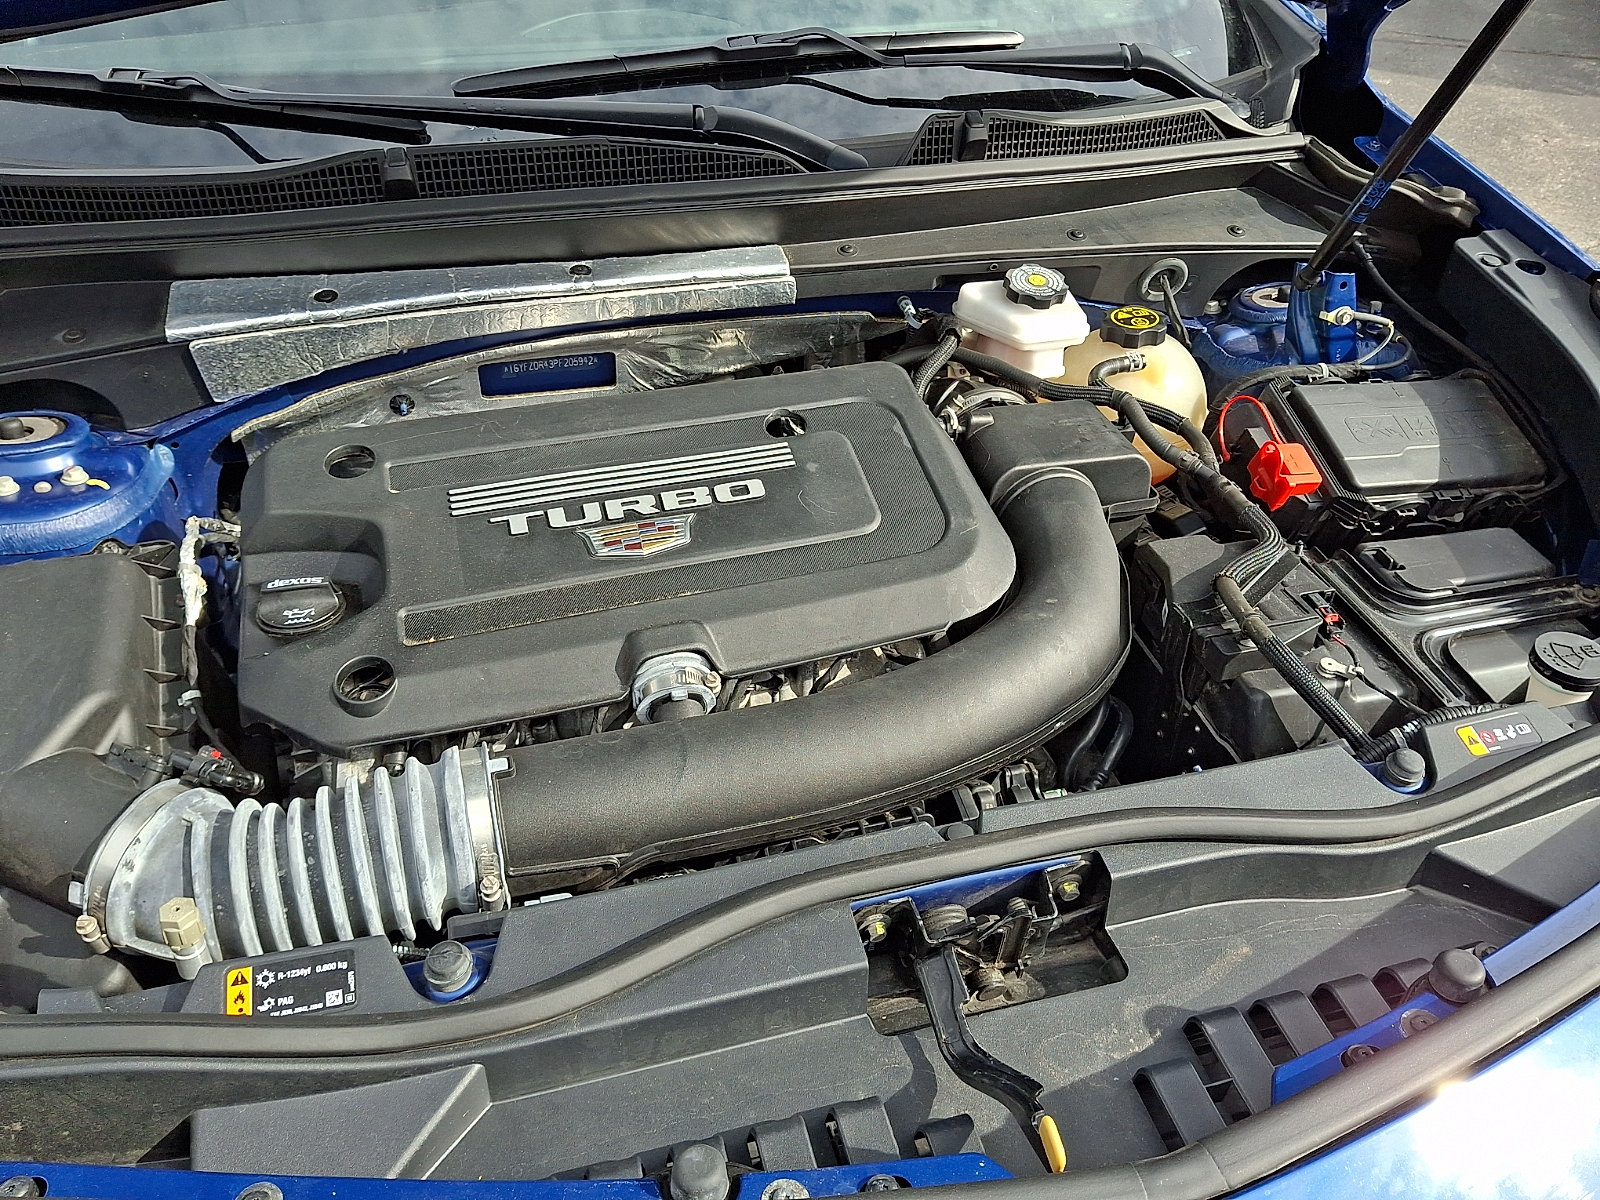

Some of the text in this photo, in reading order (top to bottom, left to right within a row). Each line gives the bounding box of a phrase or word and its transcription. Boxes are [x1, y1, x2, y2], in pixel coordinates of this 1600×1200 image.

[489, 478, 766, 536] TURBO
[266, 576, 325, 589] dexos
[277, 966, 311, 980] R-1234yf
[337, 961, 348, 970] kg
[277, 995, 294, 1006] PAG
